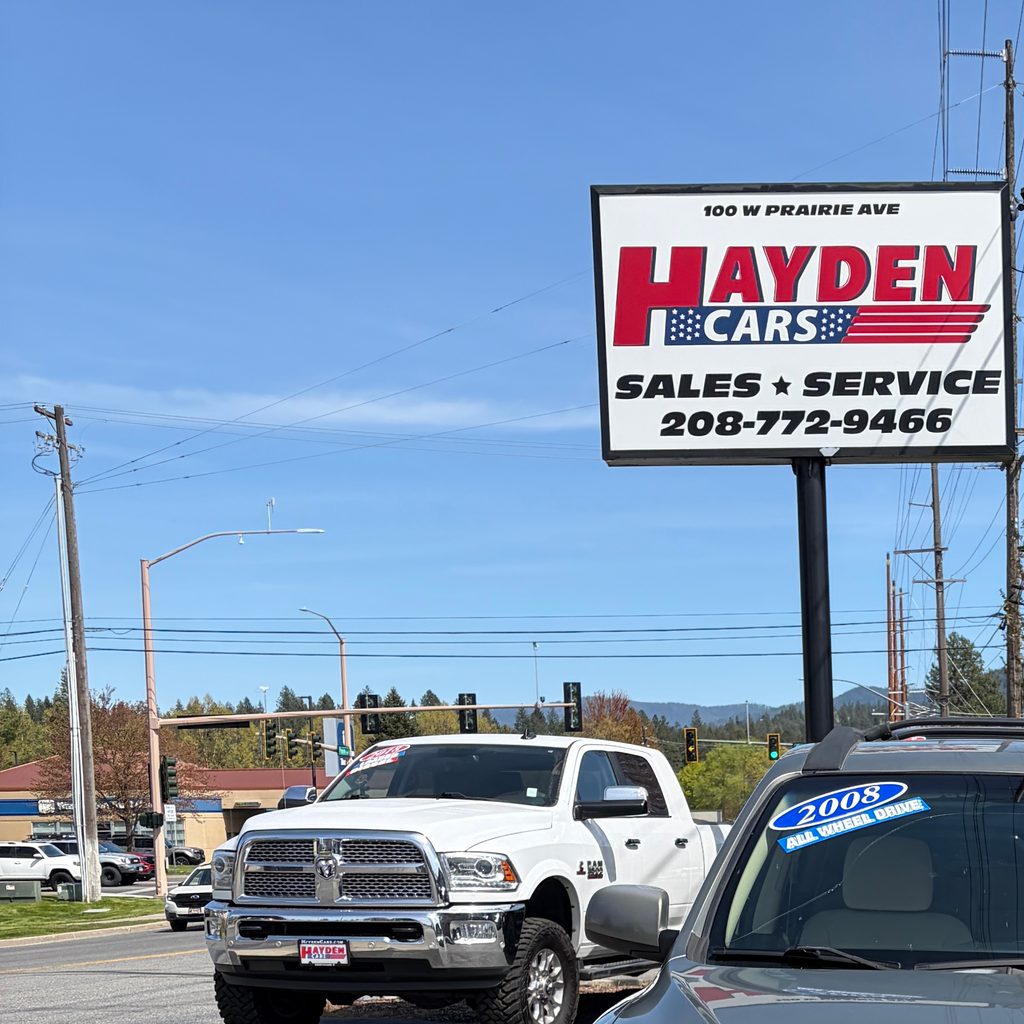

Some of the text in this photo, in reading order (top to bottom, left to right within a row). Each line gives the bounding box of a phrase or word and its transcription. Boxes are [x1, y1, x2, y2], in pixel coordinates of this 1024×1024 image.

[704, 203, 901, 217] 100 W PRAIRIE AVE
[612, 245, 978, 347] HAYDEN
[703, 308, 818, 342] CARS
[614, 370, 1002, 400] SALES SERVICE
[659, 407, 954, 437] 208-772-9466
[796, 785, 881, 826] 2008
[786, 799, 923, 850] ALL WHEEL DRIVE
[301, 945, 345, 959] HAYDEN
